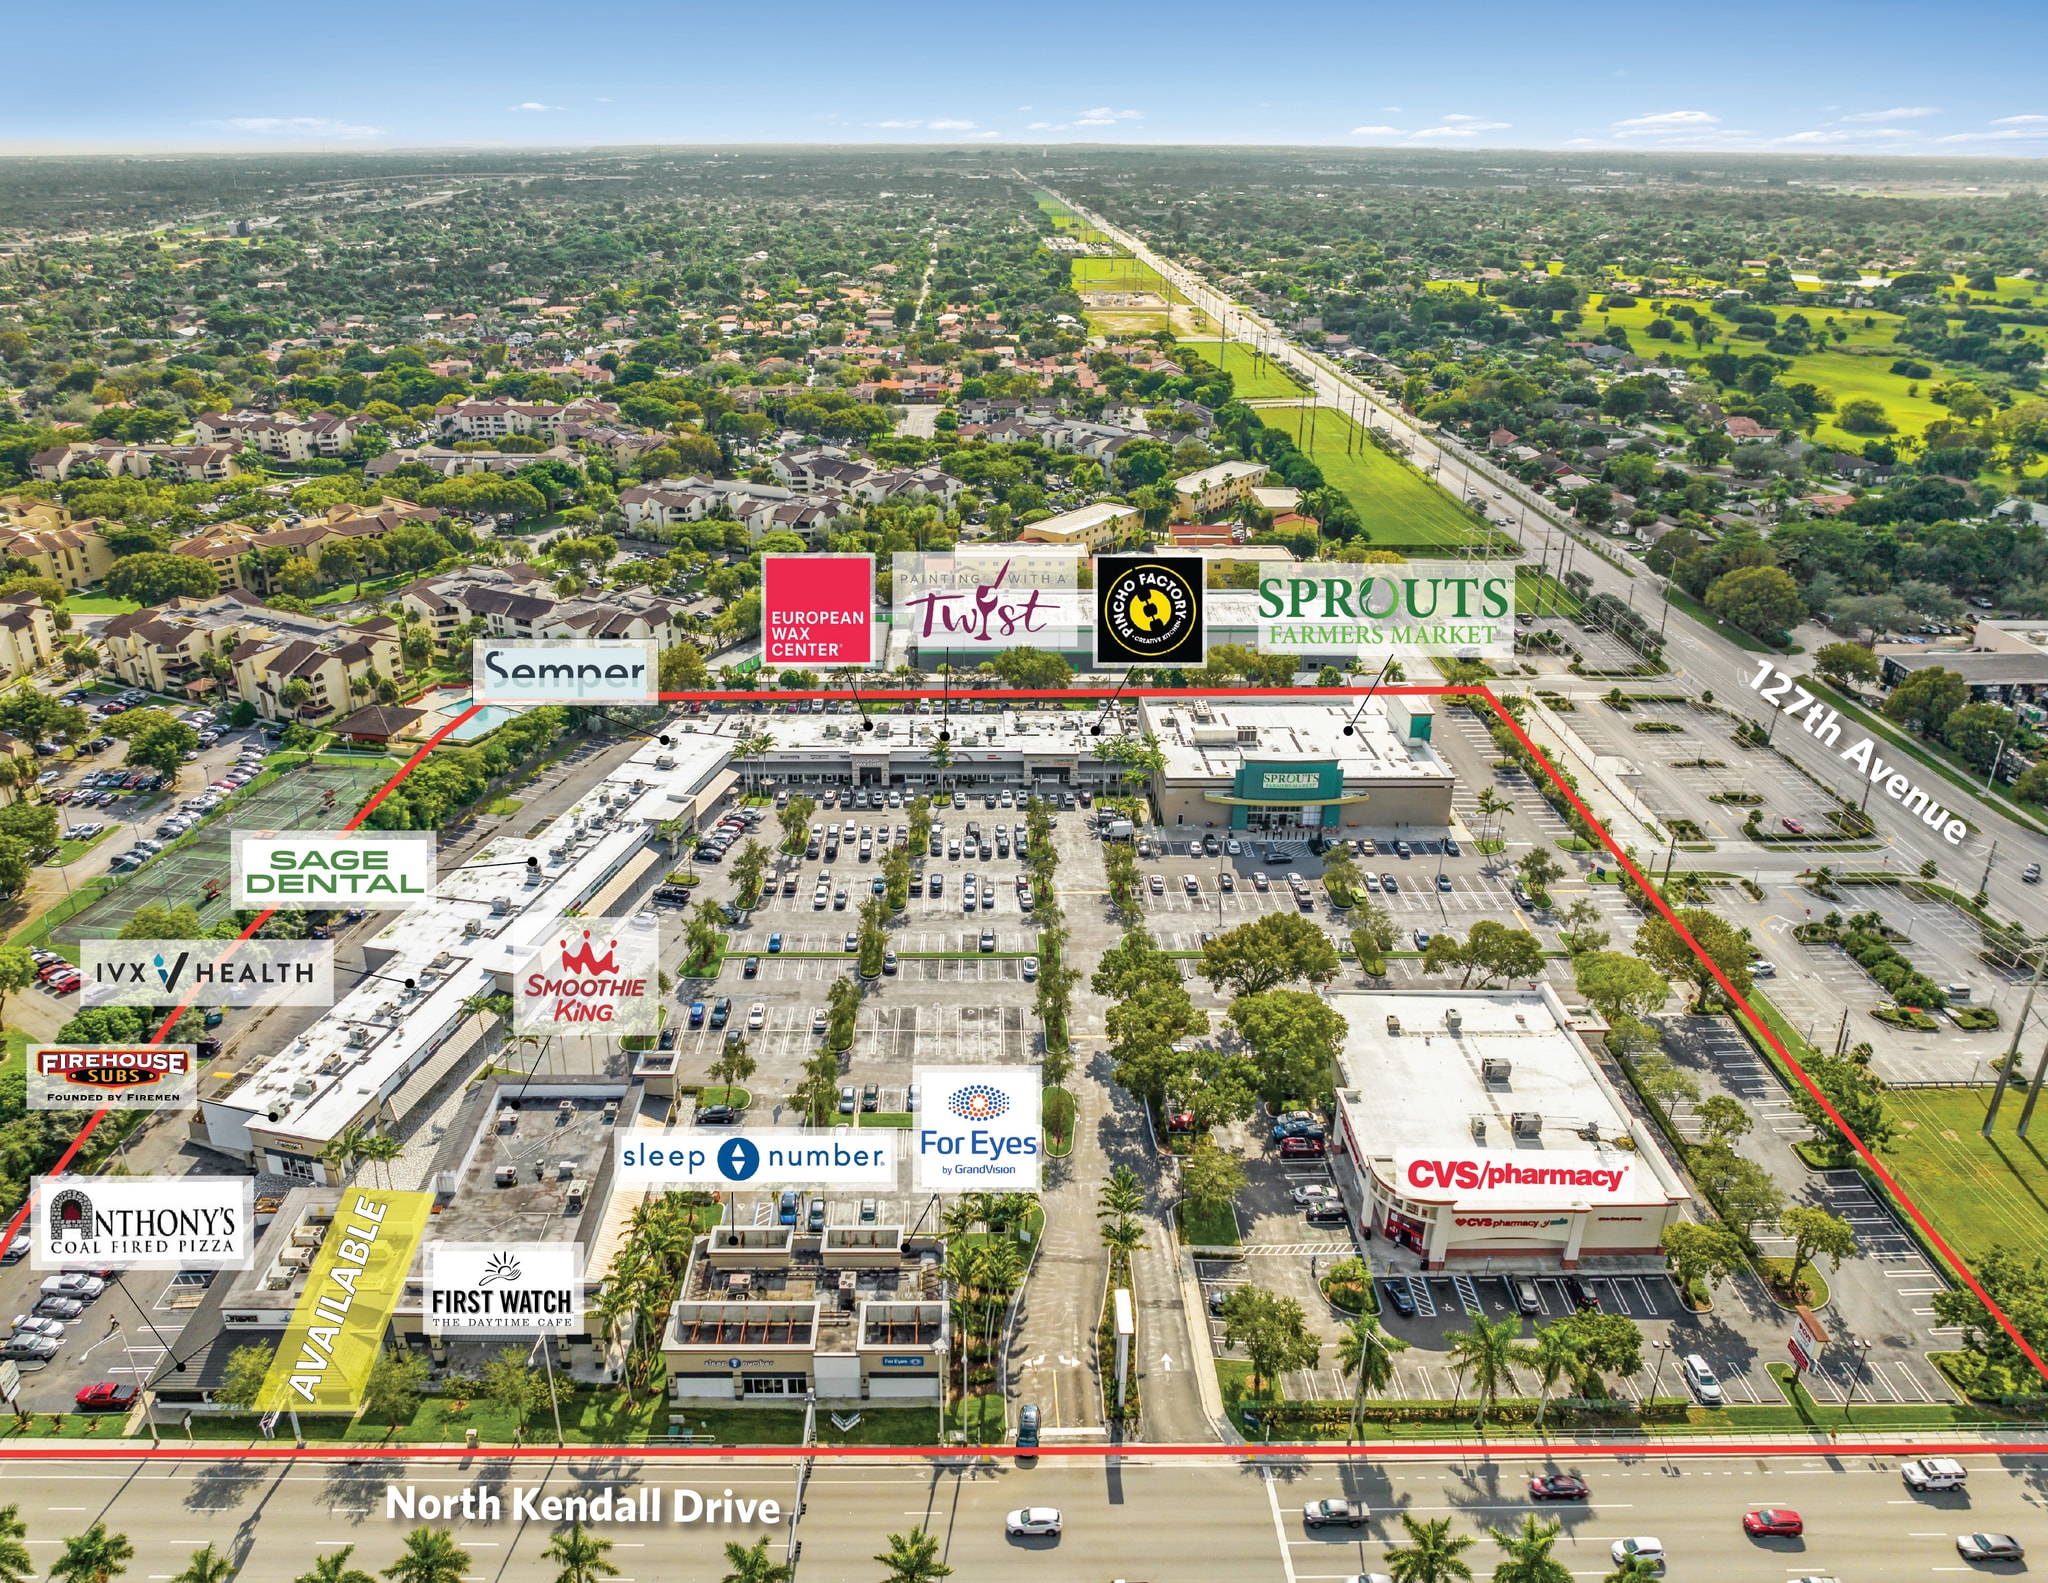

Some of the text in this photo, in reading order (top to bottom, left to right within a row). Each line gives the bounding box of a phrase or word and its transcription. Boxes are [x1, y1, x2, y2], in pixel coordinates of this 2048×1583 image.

[1264, 774, 1320, 783] SPROUTS
[1466, 1217, 1493, 1227] CVS
[1492, 1219, 1540, 1228] pharmacy
[704, 1358, 775, 1367] sleep number
[894, 1358, 908, 1366] Eyes
